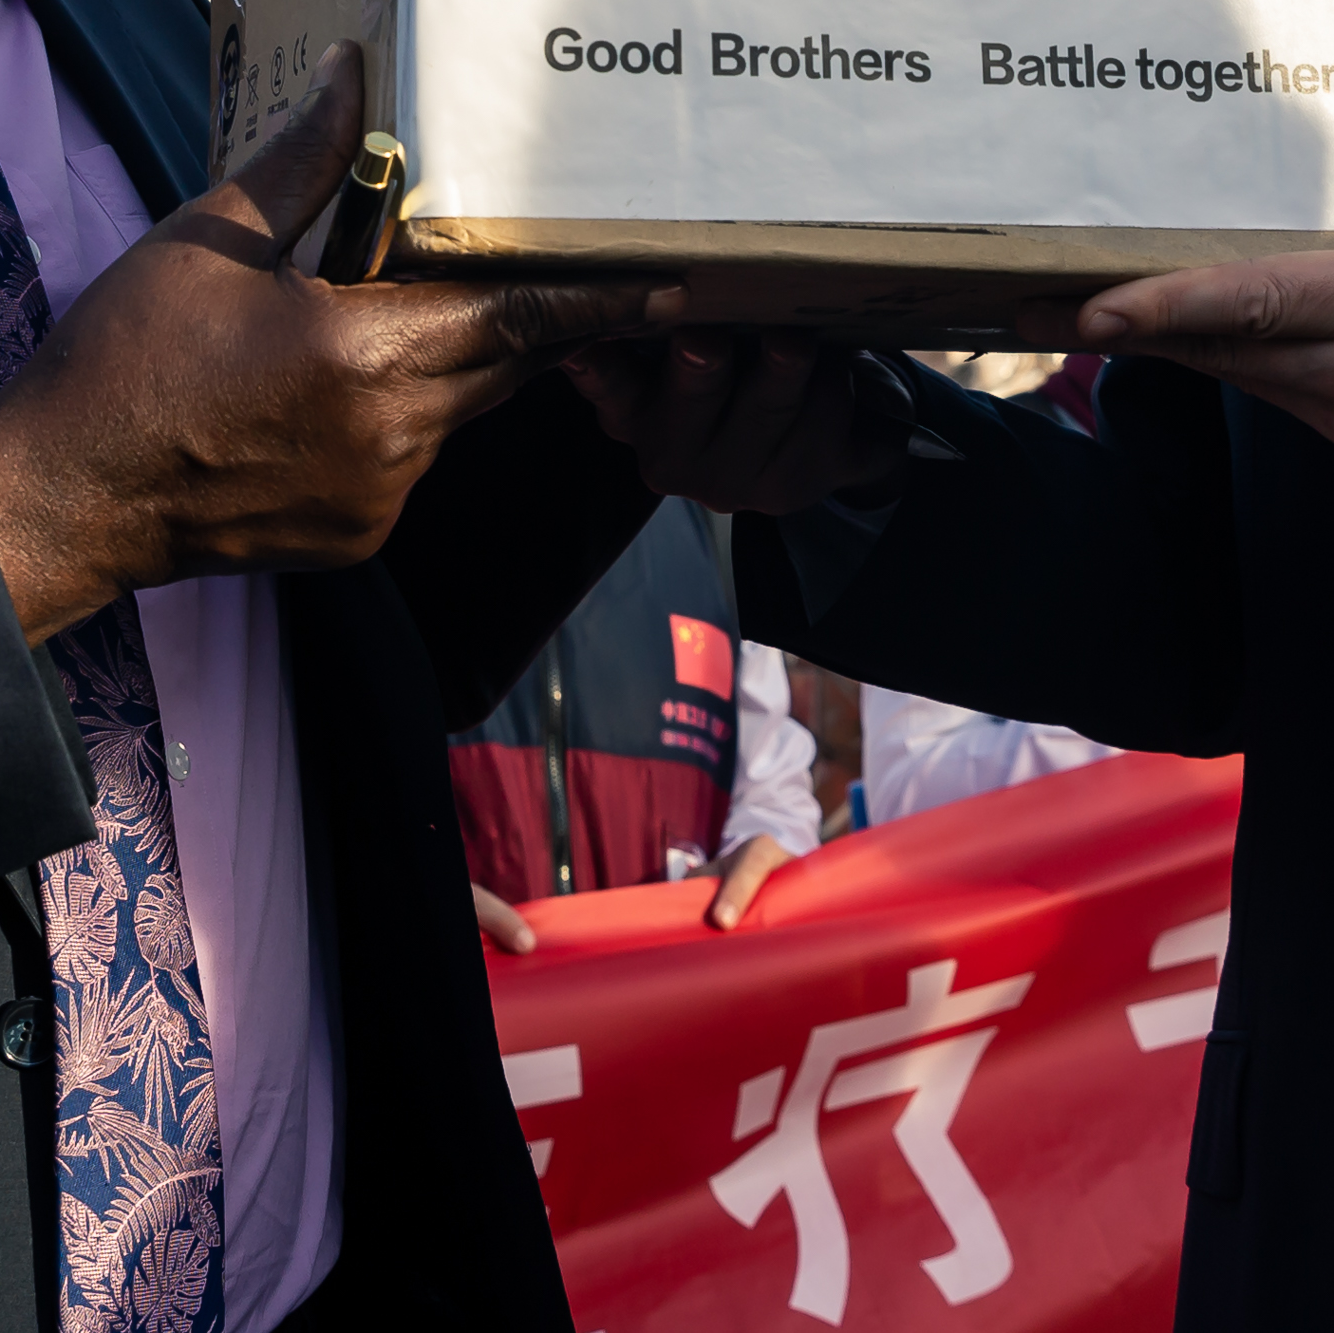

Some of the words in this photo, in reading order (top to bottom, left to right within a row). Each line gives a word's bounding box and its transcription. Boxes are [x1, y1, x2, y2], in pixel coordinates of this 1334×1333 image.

[543, 26, 683, 77] Good
[710, 31, 932, 84] Brothers
[980, 41, 1127, 90] Battle
